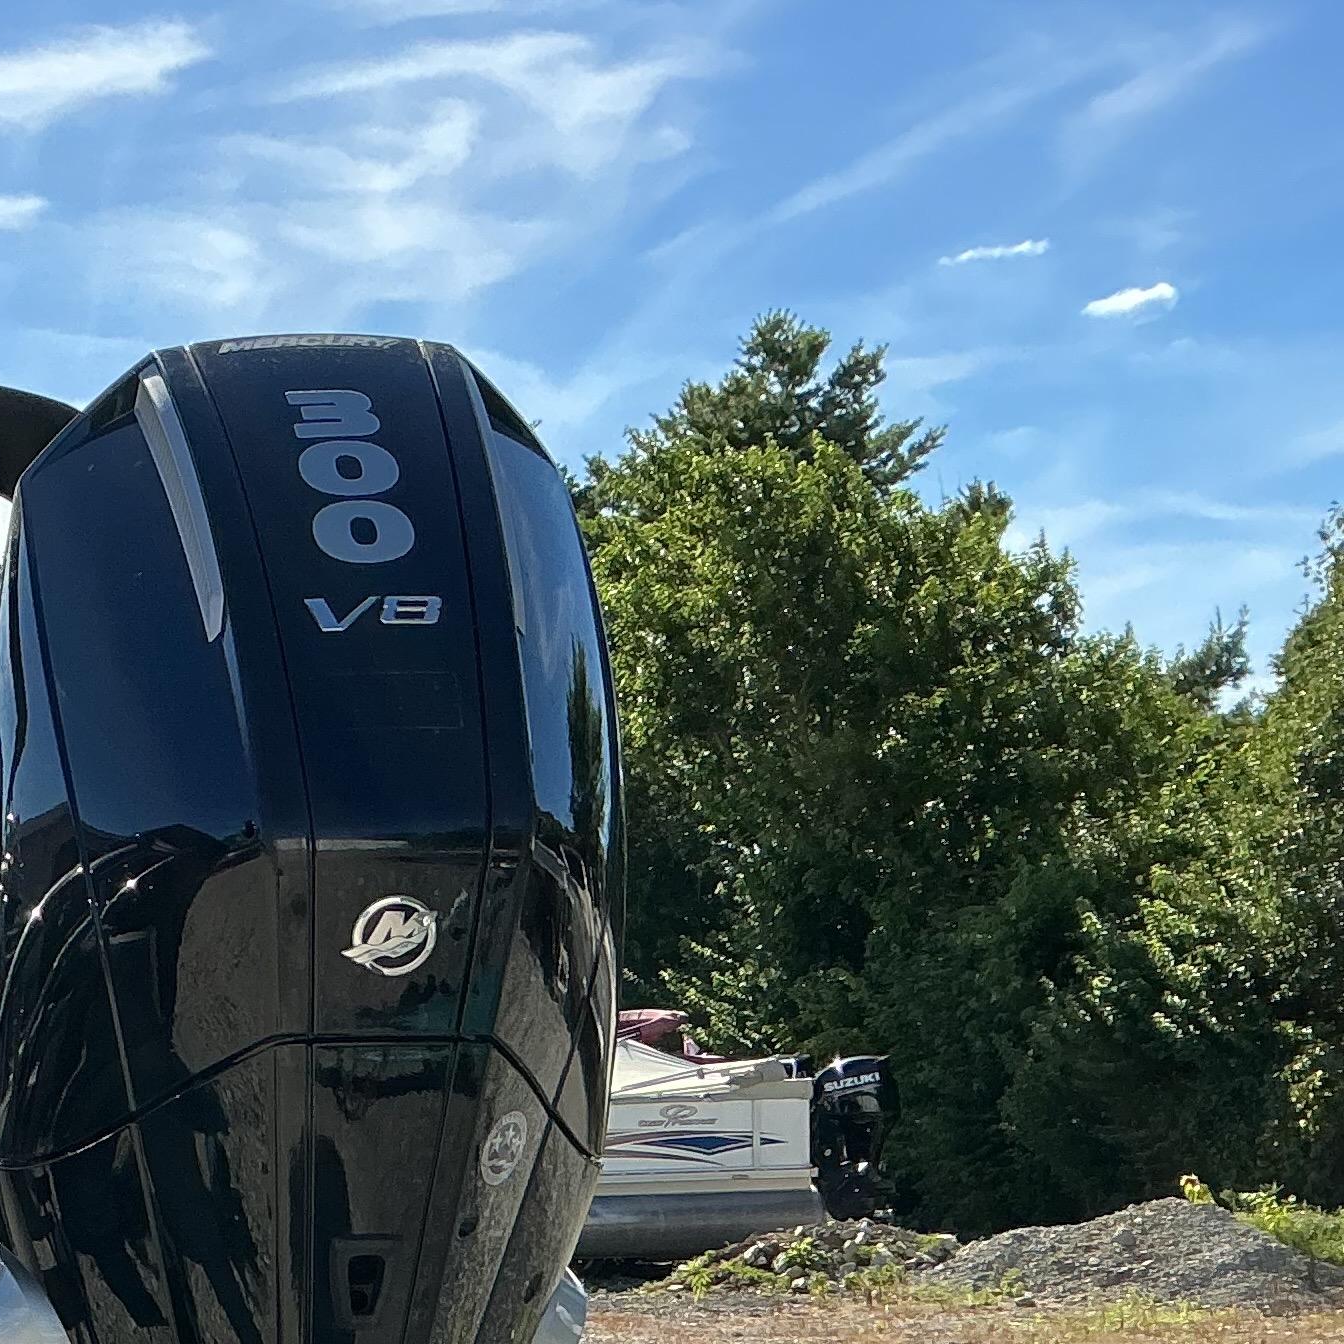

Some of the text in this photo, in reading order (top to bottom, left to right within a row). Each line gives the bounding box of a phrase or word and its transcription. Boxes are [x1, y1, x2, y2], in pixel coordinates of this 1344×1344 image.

[284, 389, 415, 564] 300
[303, 595, 443, 632] V8
[823, 1072, 881, 1092] SUZUKI
